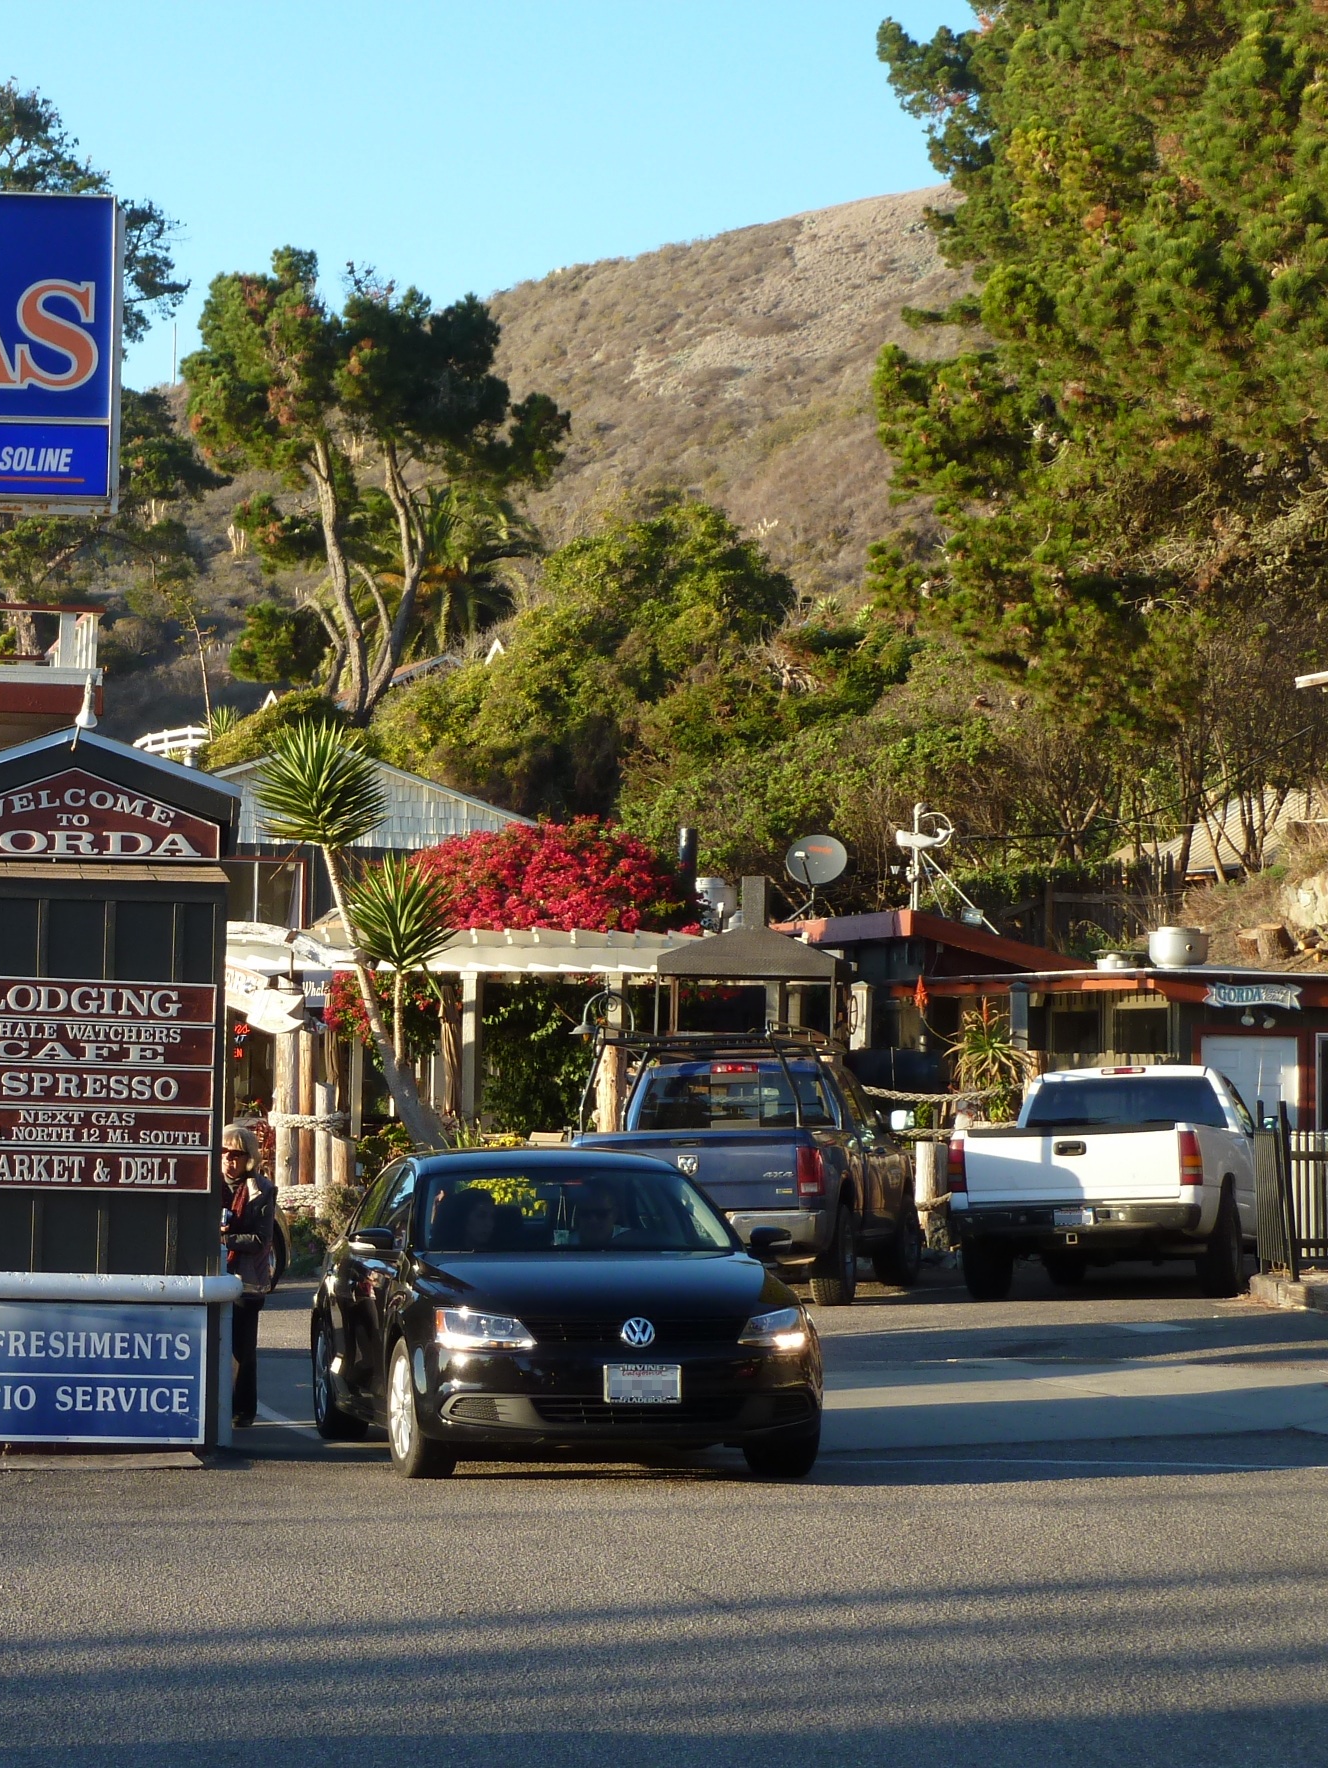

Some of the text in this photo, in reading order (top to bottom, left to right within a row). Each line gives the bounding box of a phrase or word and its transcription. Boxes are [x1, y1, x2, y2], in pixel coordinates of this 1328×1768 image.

[57, 813, 90, 827] TO
[1218, 985, 1261, 1003] GORDA
[65, 1024, 181, 1043] WATCHERS
[18, 1110, 136, 1126] NEXT GAS
[12, 1127, 75, 1142] NORTH
[81, 1128, 100, 1142] 12
[107, 1130, 134, 1144] Mi.
[139, 1131, 201, 1146] SOUTH
[93, 1158, 110, 1182] &
[119, 1157, 178, 1184] DELI
[55, 1386, 190, 1413] SERVICE
